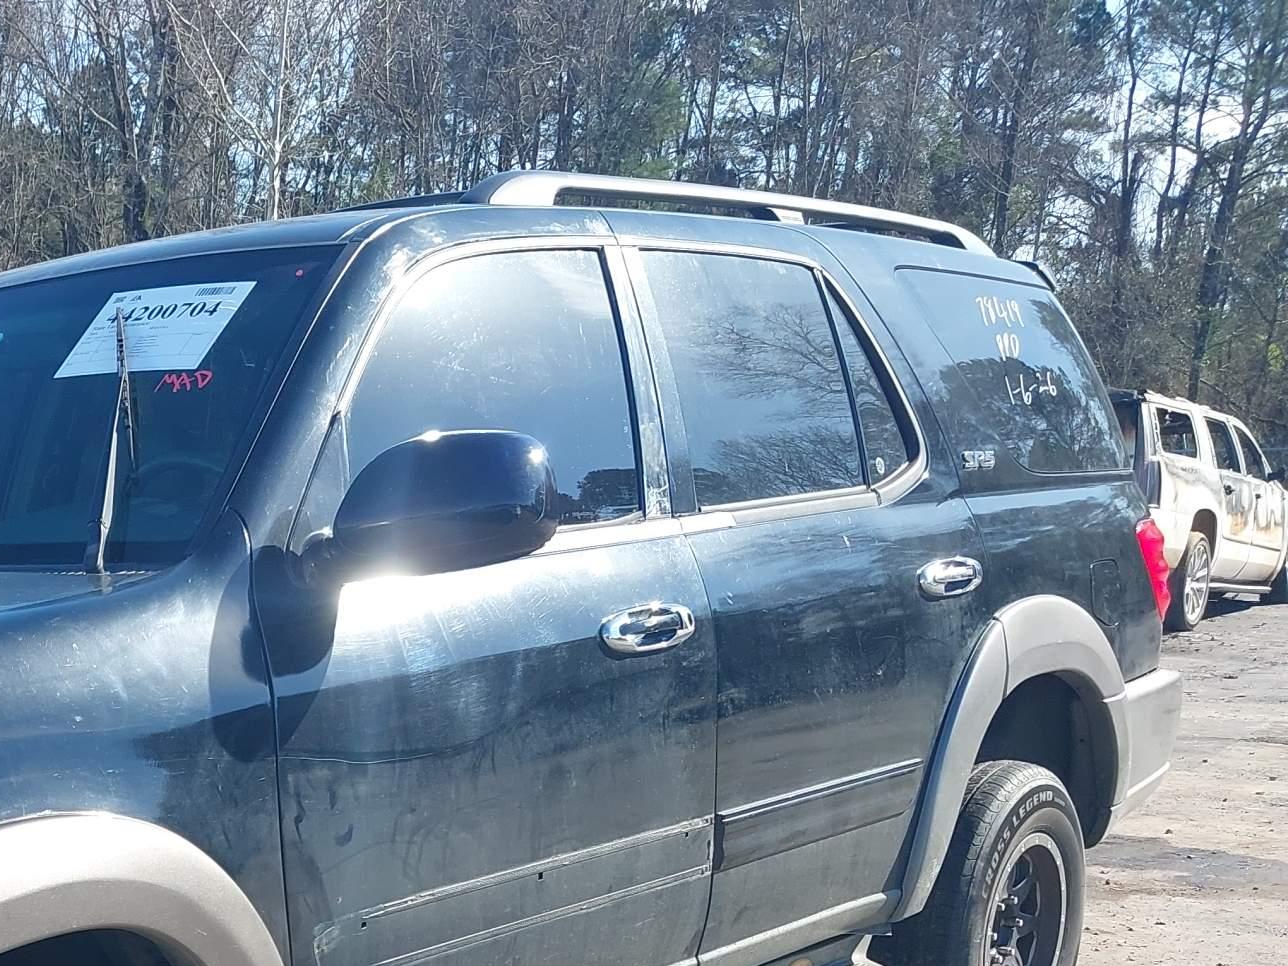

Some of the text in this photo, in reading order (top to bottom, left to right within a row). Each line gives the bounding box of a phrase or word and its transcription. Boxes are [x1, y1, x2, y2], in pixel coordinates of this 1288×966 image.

[106, 300, 223, 324] 44200704
[154, 370, 213, 393] MAD
[1012, 790, 1054, 828] LEGEND
